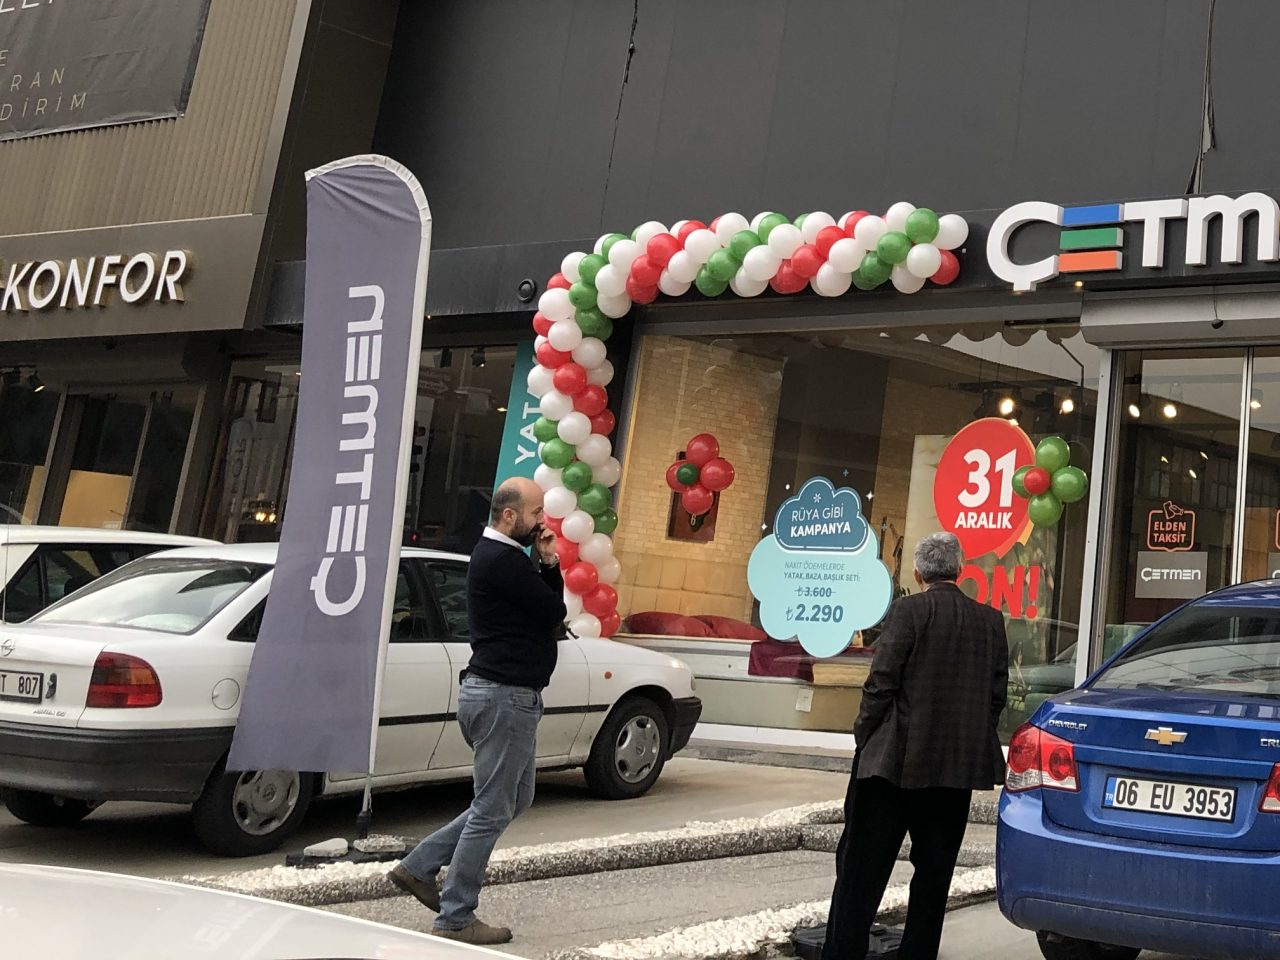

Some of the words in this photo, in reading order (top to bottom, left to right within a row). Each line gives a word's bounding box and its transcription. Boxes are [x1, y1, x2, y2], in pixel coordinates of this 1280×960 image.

[1, 249, 188, 311] KONFOR
[957, 448, 1017, 508] 31
[791, 507, 819, 522] RÜYA
[822, 503, 844, 519] GİBİ
[954, 511, 1013, 530] ARALIK
[790, 521, 851, 538] KAMPANYA
[1153, 521, 1187, 531] ELDEN
[18, 676, 39, 696] 807
[1115, 779, 1139, 806] 06
[1150, 784, 1175, 810] EU
[1183, 788, 1233, 818] 3953
